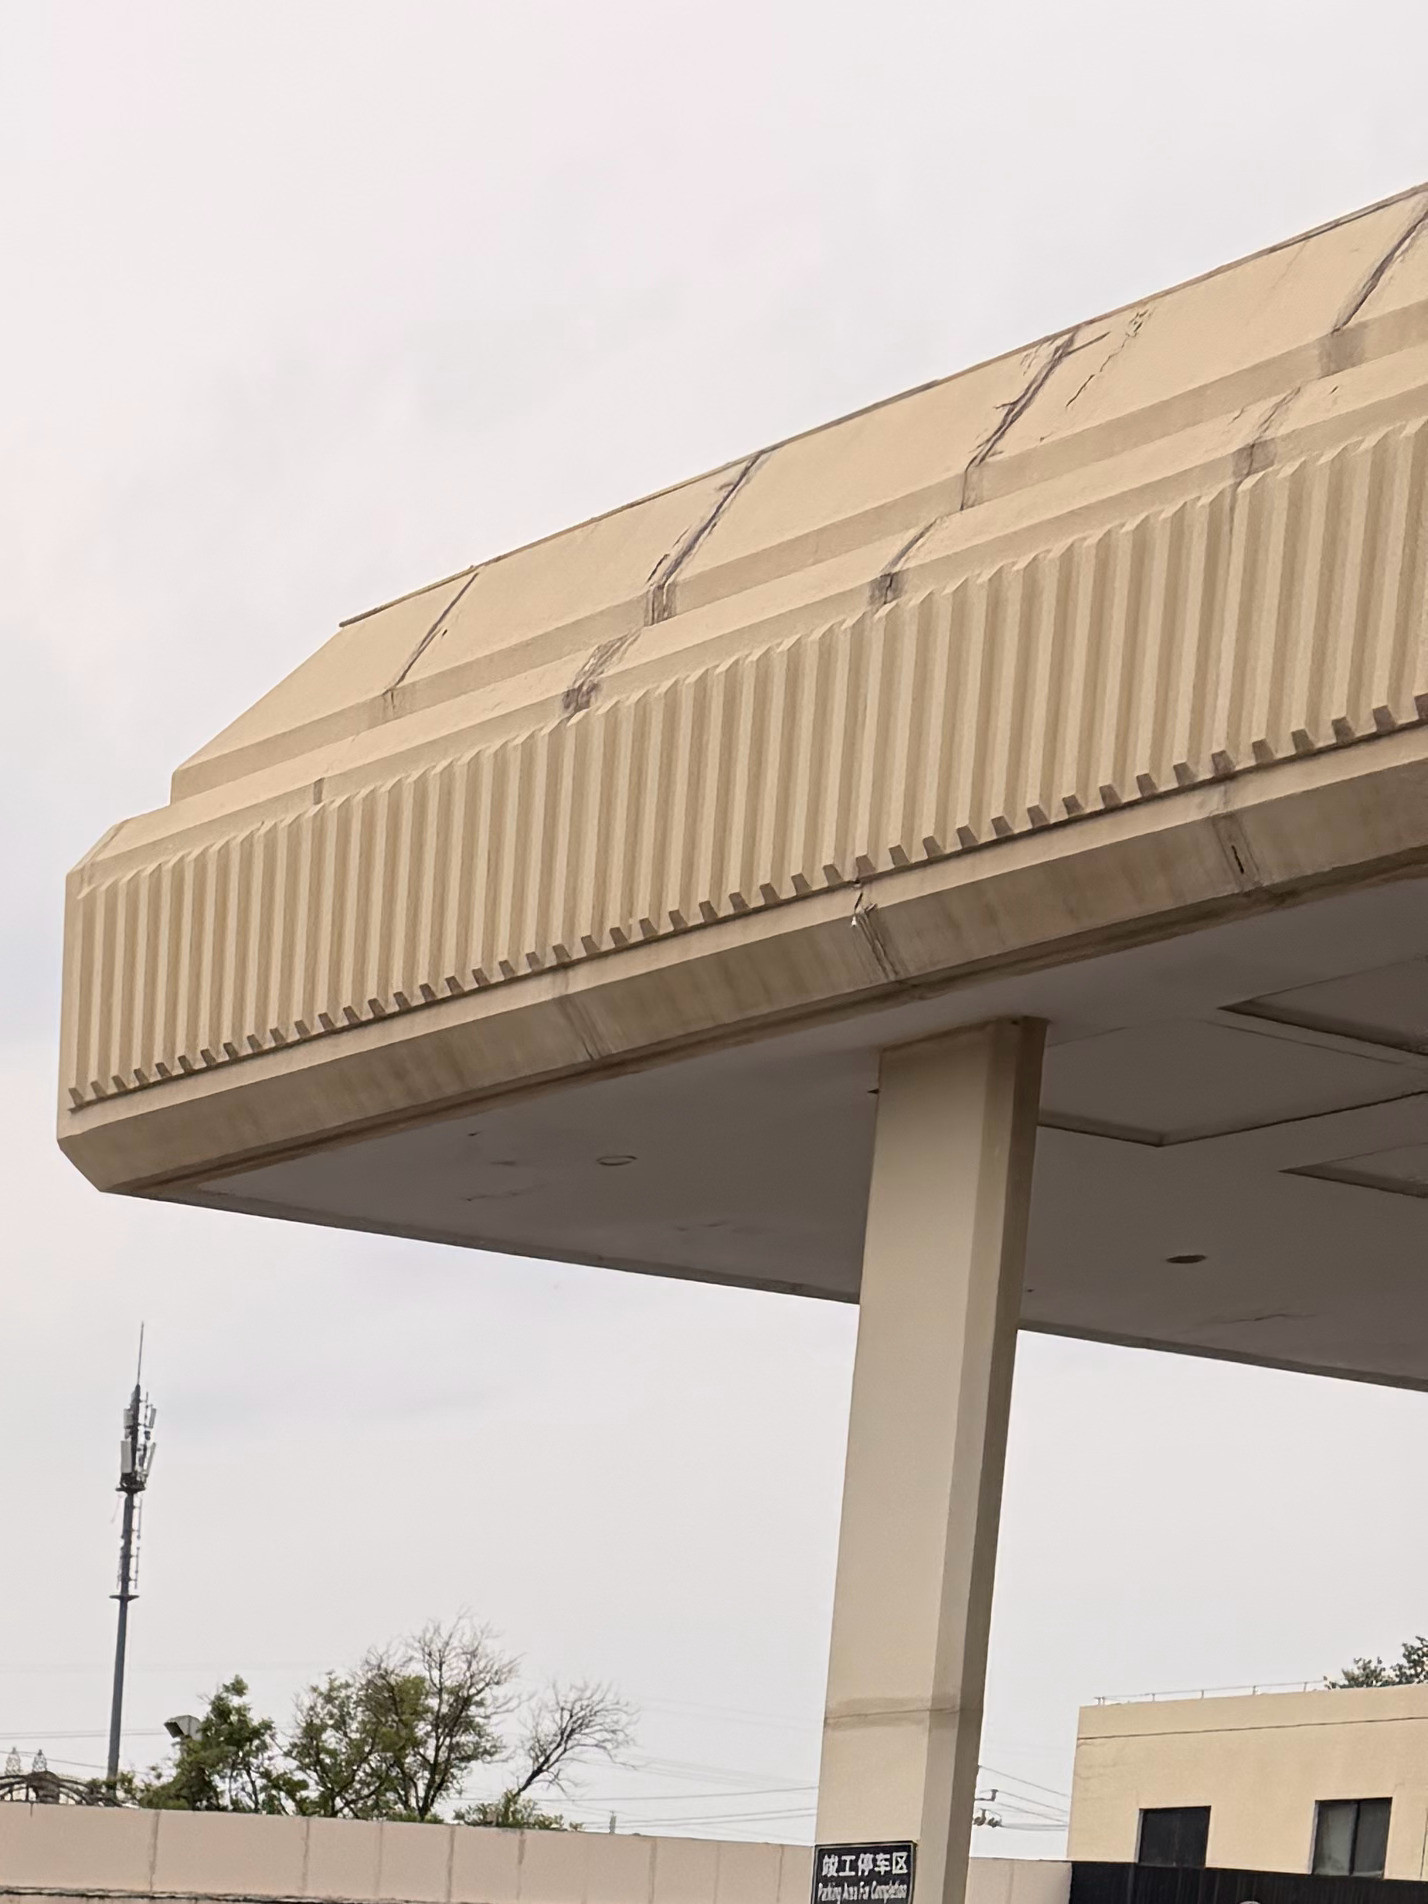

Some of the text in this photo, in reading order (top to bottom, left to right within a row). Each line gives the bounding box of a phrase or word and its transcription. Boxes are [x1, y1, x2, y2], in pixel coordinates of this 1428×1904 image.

[822, 1852, 908, 1877] 竣工停车区
